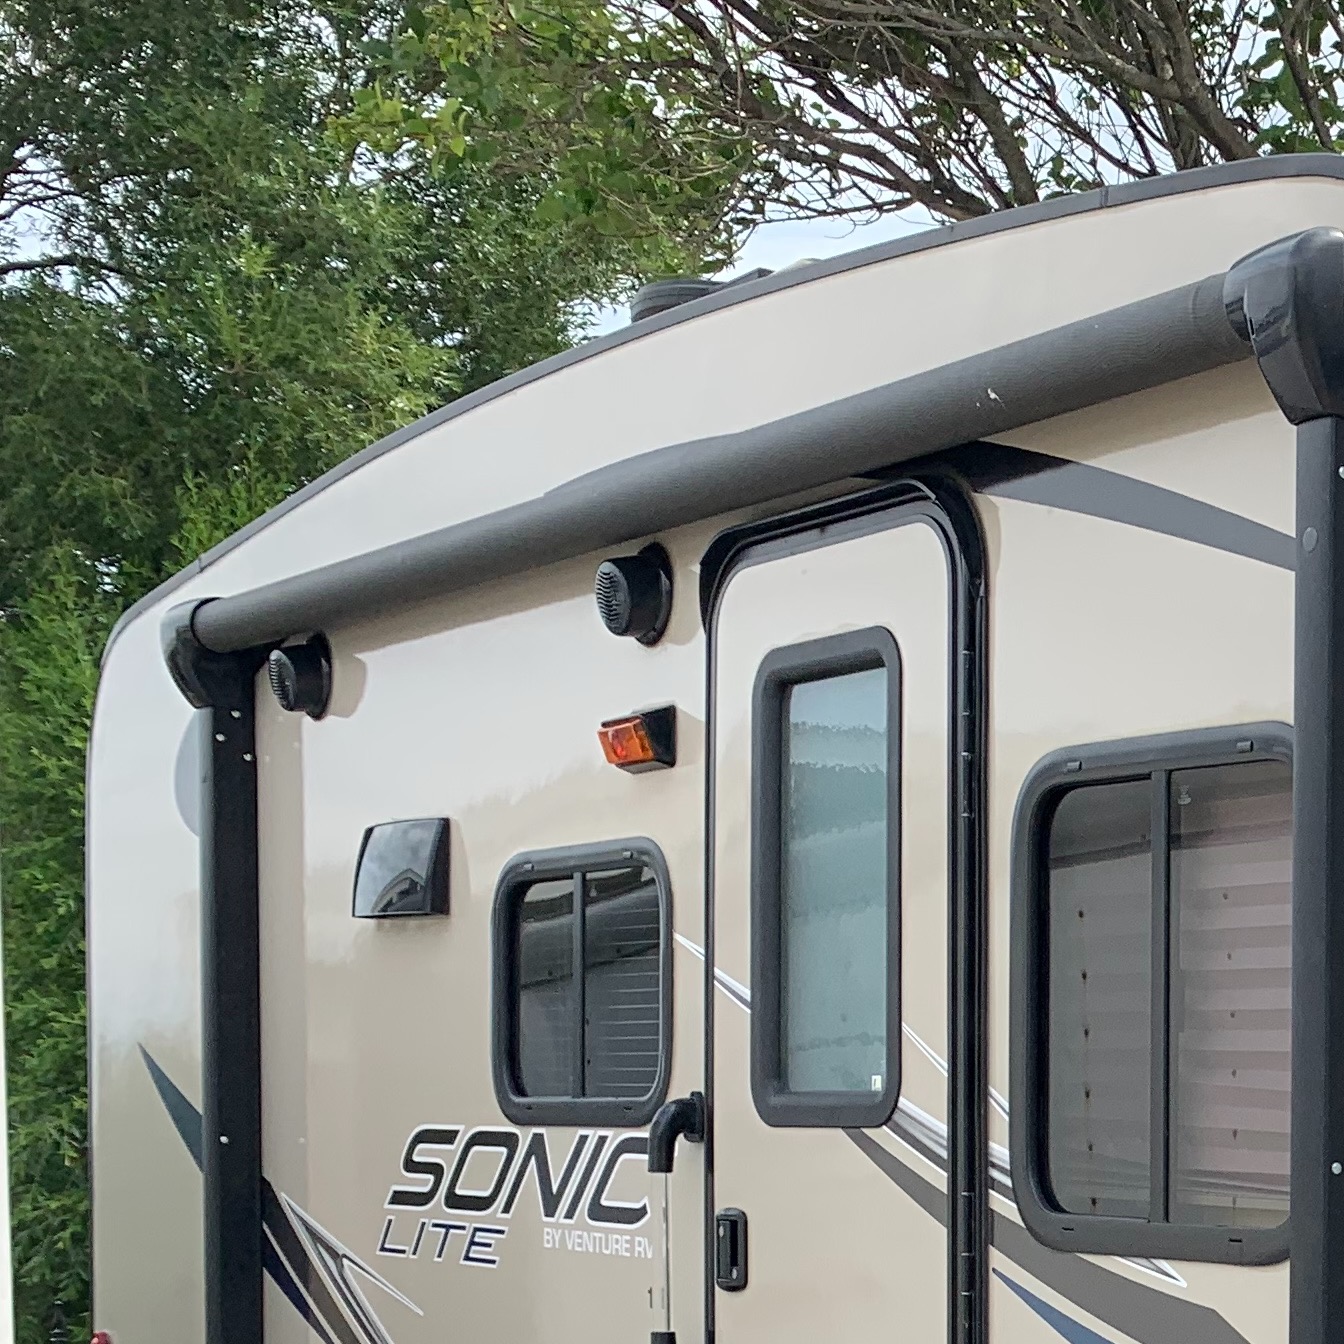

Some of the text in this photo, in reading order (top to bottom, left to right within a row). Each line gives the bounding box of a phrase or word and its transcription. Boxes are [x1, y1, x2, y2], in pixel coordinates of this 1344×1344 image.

[384, 1124, 651, 1230] SONIC
[376, 1214, 508, 1269] LITE
[543, 1227, 654, 1260] BY VENTURE RV
